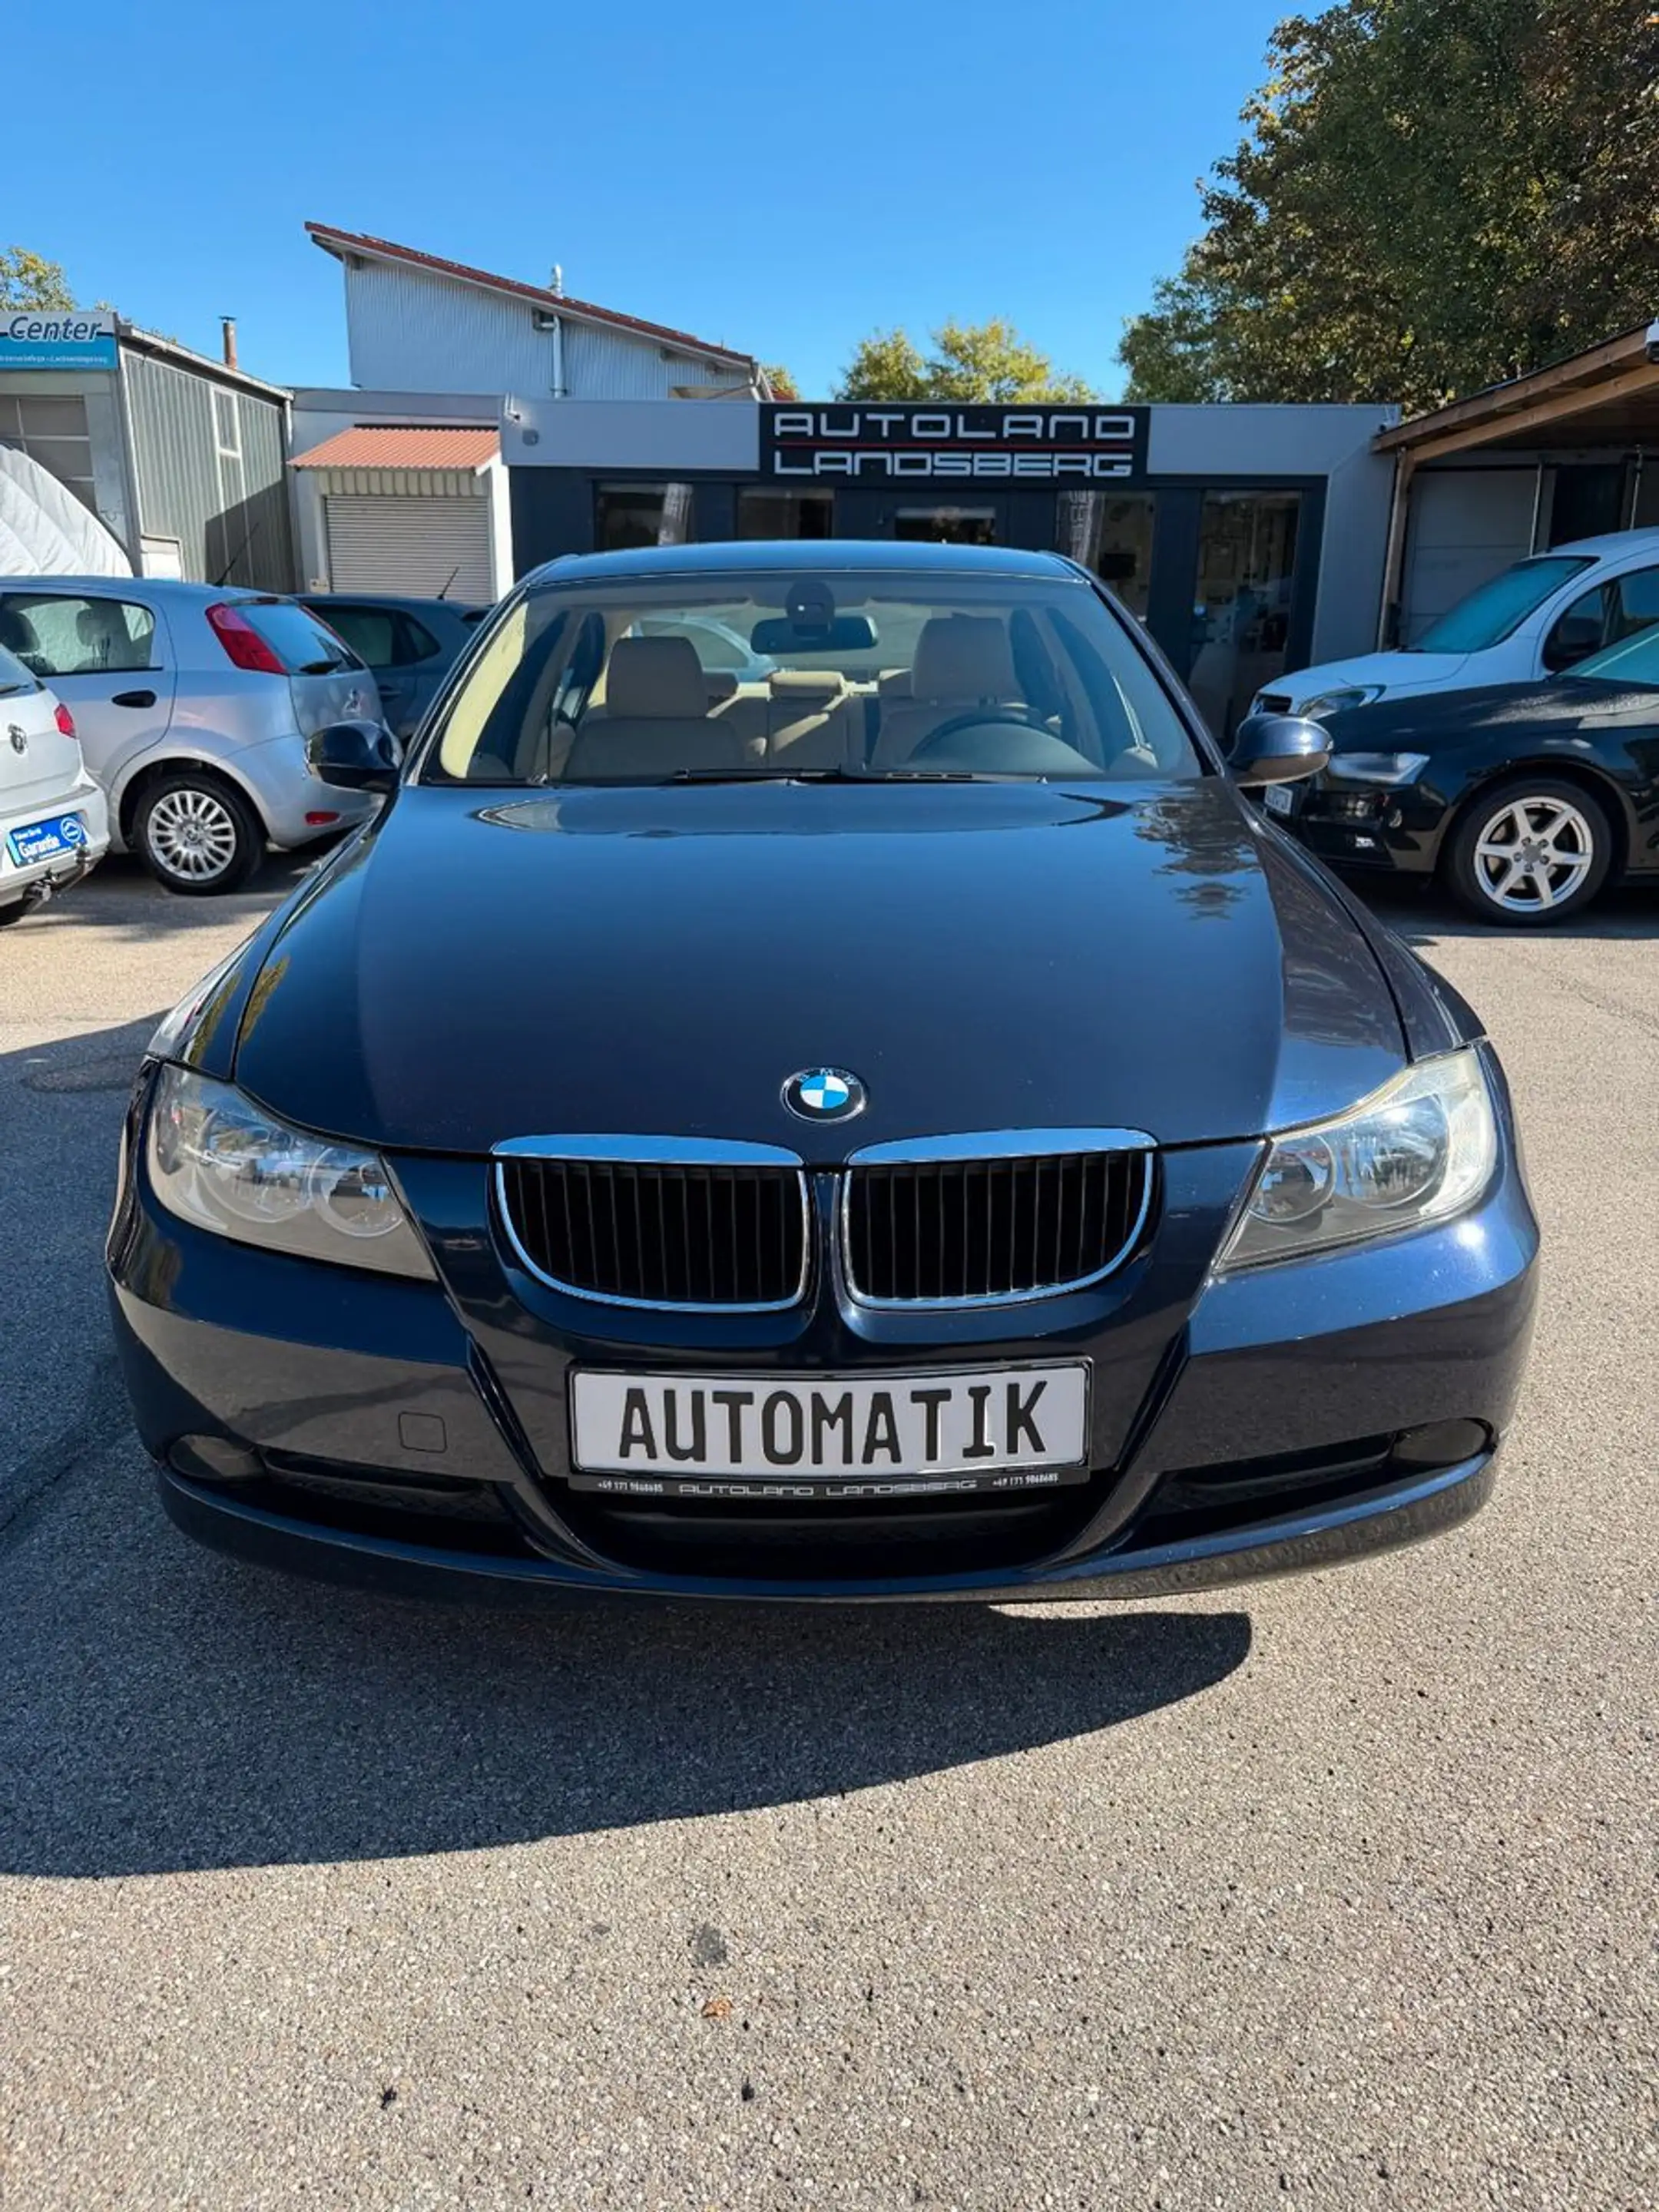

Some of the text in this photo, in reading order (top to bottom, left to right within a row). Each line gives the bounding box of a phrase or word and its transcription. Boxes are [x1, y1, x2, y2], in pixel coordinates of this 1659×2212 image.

[9, 316, 102, 339] Center
[773, 412, 1135, 439] AUTOLAND
[773, 450, 1134, 478] LANDSBERG
[618, 1380, 1048, 1465] AUTOMATIK
[678, 1483, 814, 1496] AUTOLAND
[825, 1479, 978, 1497] LANDSBERG
